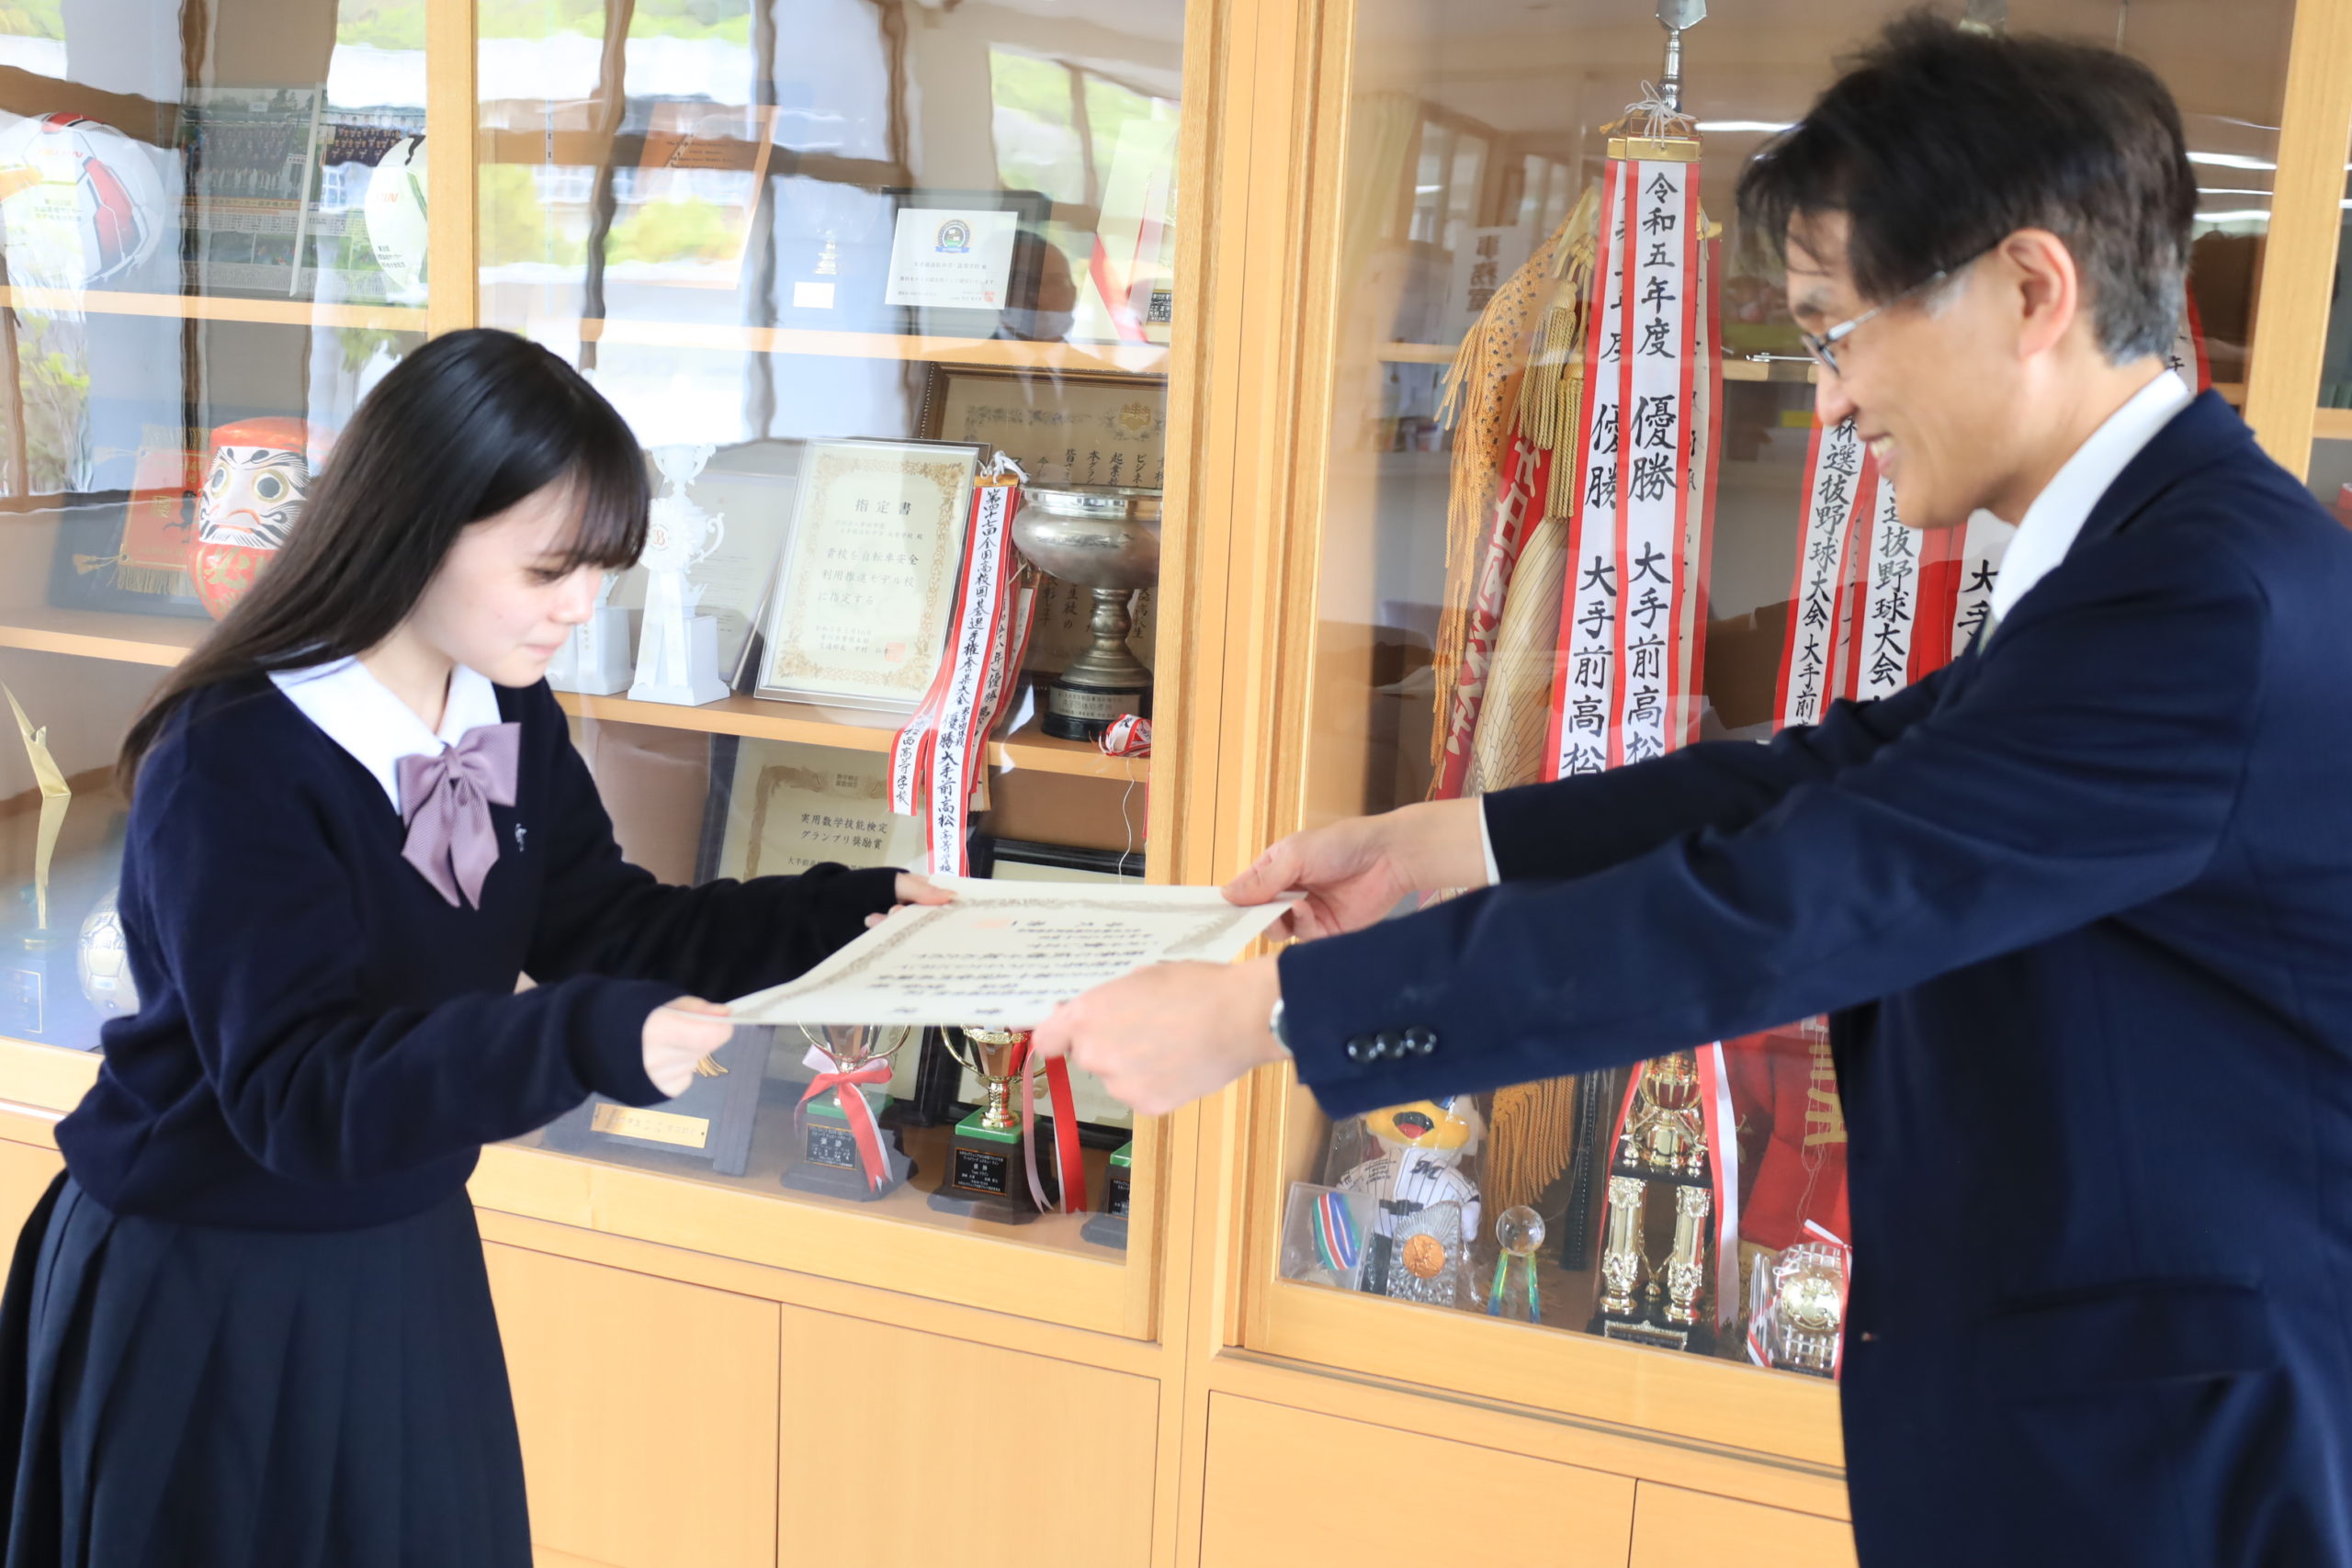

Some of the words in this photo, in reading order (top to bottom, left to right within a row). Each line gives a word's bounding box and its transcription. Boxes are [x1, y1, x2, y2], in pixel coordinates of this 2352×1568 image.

[1636, 172, 1679, 358] 令和五年度
[1628, 394, 1678, 502] 優勝
[1624, 541, 1671, 766] 大手前高松
[1870, 478, 1915, 686] 抜野球大会
[1561, 556, 1617, 774] 大手前高松
[1795, 634, 1824, 728] 大手前
[800, 813, 888, 834] 実用数学技能検定
[800, 829, 883, 850] グランプリ奨励賞
